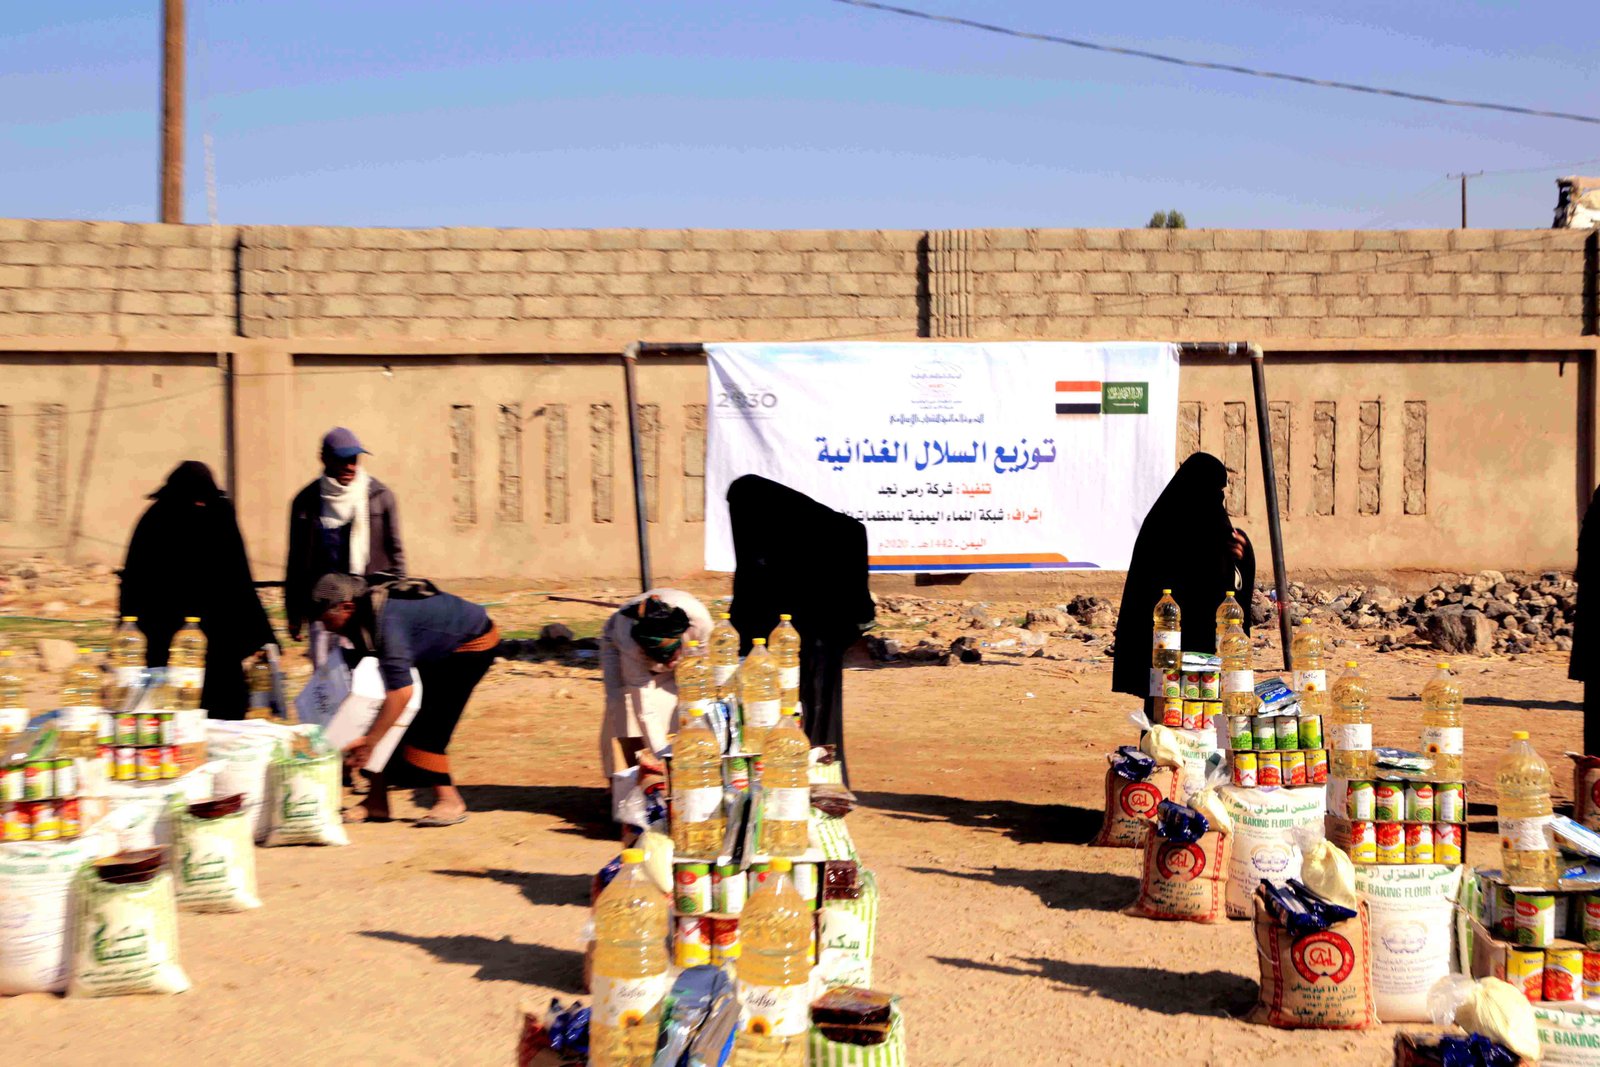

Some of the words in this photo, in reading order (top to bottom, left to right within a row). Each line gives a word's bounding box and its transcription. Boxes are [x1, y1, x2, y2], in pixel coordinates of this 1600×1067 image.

[815, 436, 909, 472] الغذائية
[914, 439, 987, 471] السلال
[993, 438, 1057, 474] توزيع
[926, 482, 953, 498] شركة
[978, 508, 1004, 524] شبكة
[1242, 815, 1270, 829] BAKING
[1271, 818, 1295, 828] FLOUR
[1368, 882, 1402, 899] BAKING
[1404, 885, 1432, 899] FLOUR
